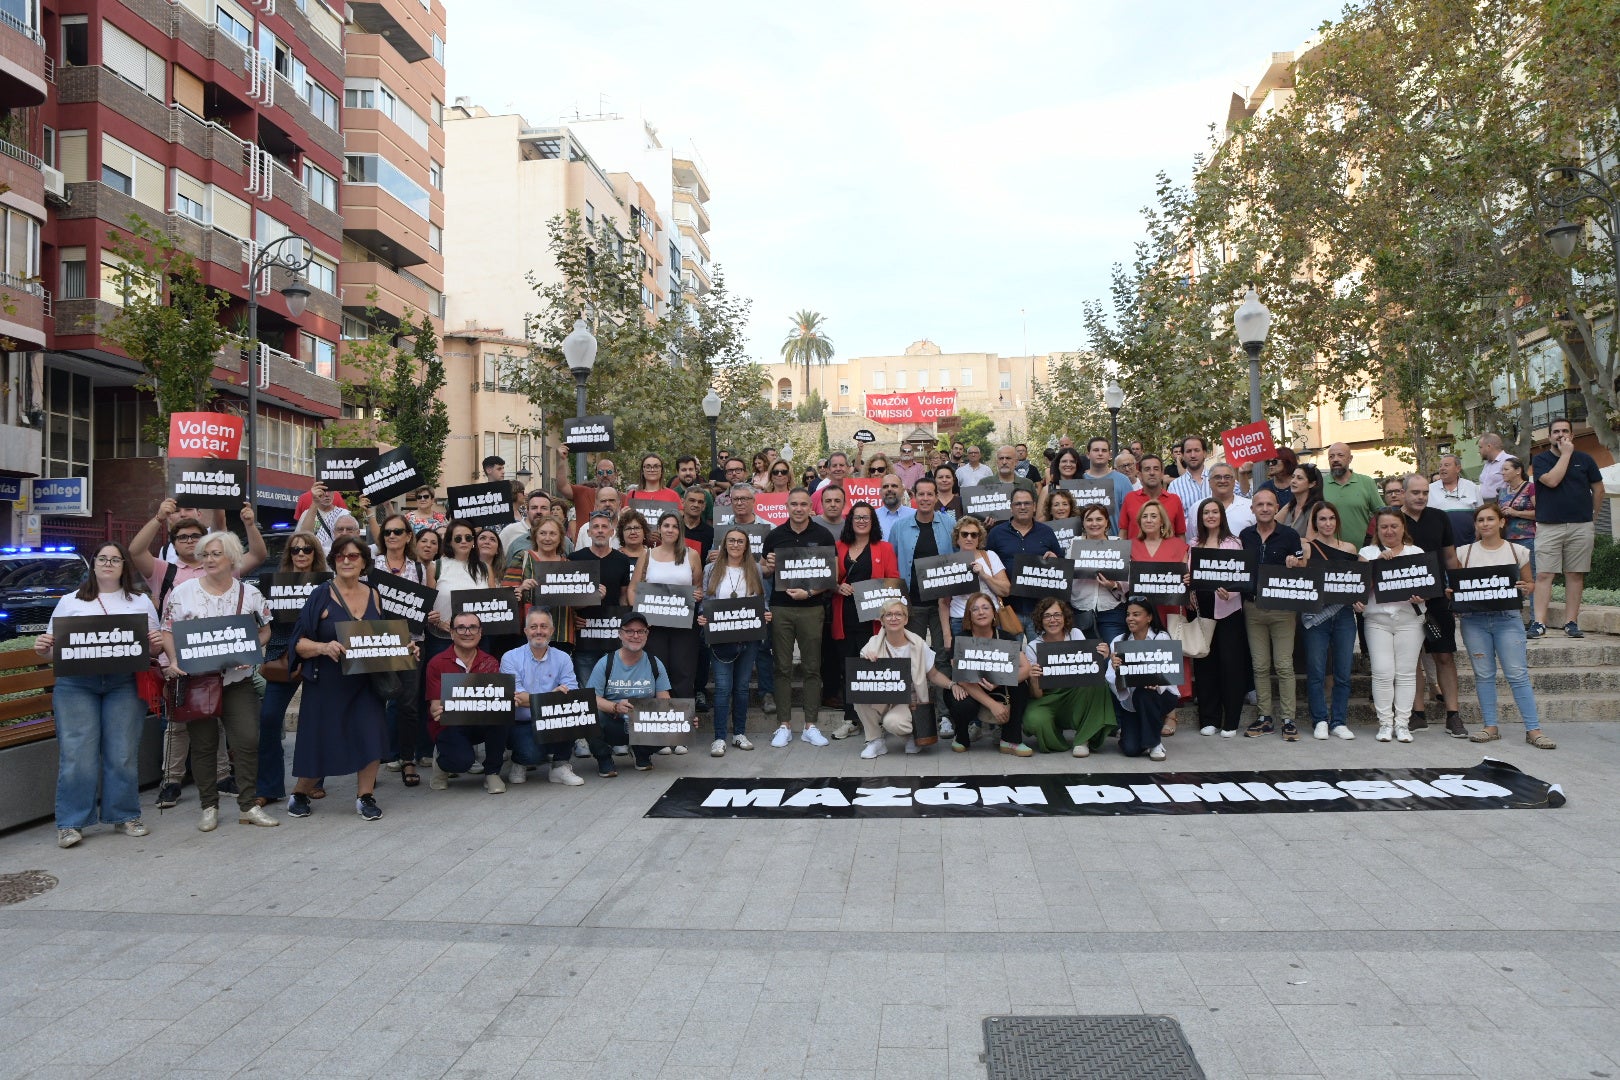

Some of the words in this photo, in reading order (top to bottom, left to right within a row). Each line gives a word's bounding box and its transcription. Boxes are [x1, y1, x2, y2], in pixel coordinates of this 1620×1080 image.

[918, 395, 954, 405] Volem
[868, 408, 912, 418] DIMISSIÓ
[178, 420, 234, 438] Volem
[570, 424, 605, 434] MAZÓN
[180, 436, 230, 452] votar.
[1227, 432, 1264, 448] Volem
[1232, 444, 1266, 460] votar.
[182, 470, 234, 484] MAZÓN
[363, 460, 408, 486] MAZÓN
[34, 484, 80, 498] gallego
[176, 484, 240, 496] DIMISSIÓ
[256, 490, 274, 500] SCUELA
[458, 492, 502, 507] MAZÓN
[970, 492, 1007, 504] MAZÓN
[454, 502, 510, 519] DIMISIÓN
[1080, 548, 1120, 559] MAZÓN
[784, 556, 826, 568] MAZÓN
[1074, 559, 1124, 570] DIMISSIÓ
[1200, 558, 1245, 571] MAZÓN
[546, 571, 590, 583] MAZÓN
[780, 566, 832, 580] DIMISSIÓ
[926, 562, 968, 578] MAZÓN
[1023, 566, 1064, 579] MAZÓN
[1193, 570, 1250, 582] DIMISIÓN
[1382, 565, 1428, 580] MAZÓN
[923, 570, 974, 589] DIMISSIÓ
[1016, 576, 1067, 590] DIMISSIÓ
[1140, 572, 1181, 584] MAZÓN
[1268, 577, 1314, 590] MAZÓN
[1378, 574, 1435, 591] DIMISSIÓ
[1459, 575, 1510, 590] MAZÓN
[541, 582, 596, 594] DIMISSIÓ
[864, 587, 902, 600] MAZÓN
[1134, 582, 1186, 594] DIMISSIÓ
[1262, 588, 1318, 601] DIMISSIÓ
[1324, 582, 1366, 593] MISSIÓ
[377, 584, 425, 609] MAZÓN
[644, 595, 686, 606] MAZÓN
[1454, 588, 1518, 602] DIMISIÓN
[382, 597, 426, 622] MISIÓN
[463, 599, 507, 612] MAZÓN
[638, 604, 689, 617] DIMISSIÓ
[713, 608, 756, 621] MAZÓN
[709, 617, 762, 632] DIMISSIÓ
[69, 628, 134, 645] MAZÓN
[186, 626, 246, 645] MAZÓN
[350, 632, 401, 648] MAZÓN
[580, 629, 619, 638] DIMISS
[61, 641, 142, 660] DIMISSIÓ
[180, 639, 256, 660] DIMISIÓN
[965, 649, 1009, 662] MAZÓN
[1125, 649, 1172, 662] MAZÓN
[1048, 650, 1093, 664] MAZÓN
[958, 659, 1014, 673] DIMISSIÓ
[1042, 662, 1099, 676] DIMISSIÓ
[1120, 661, 1179, 675] DIMISIÓN
[857, 668, 900, 680] MAZÓN
[452, 684, 505, 698] MAZÓN
[851, 679, 906, 692] DIMISSIÓ
[445, 698, 512, 712] DIMISIÓN
[541, 700, 589, 717] MAZÓN
[536, 712, 596, 731] DIMISIÓN
[639, 710, 685, 722] MAZÓN
[634, 721, 691, 732] DIMISSIÓ
[700, 782, 1049, 807] MAZÓN
[1066, 774, 1513, 804] DIMISSIÓ
